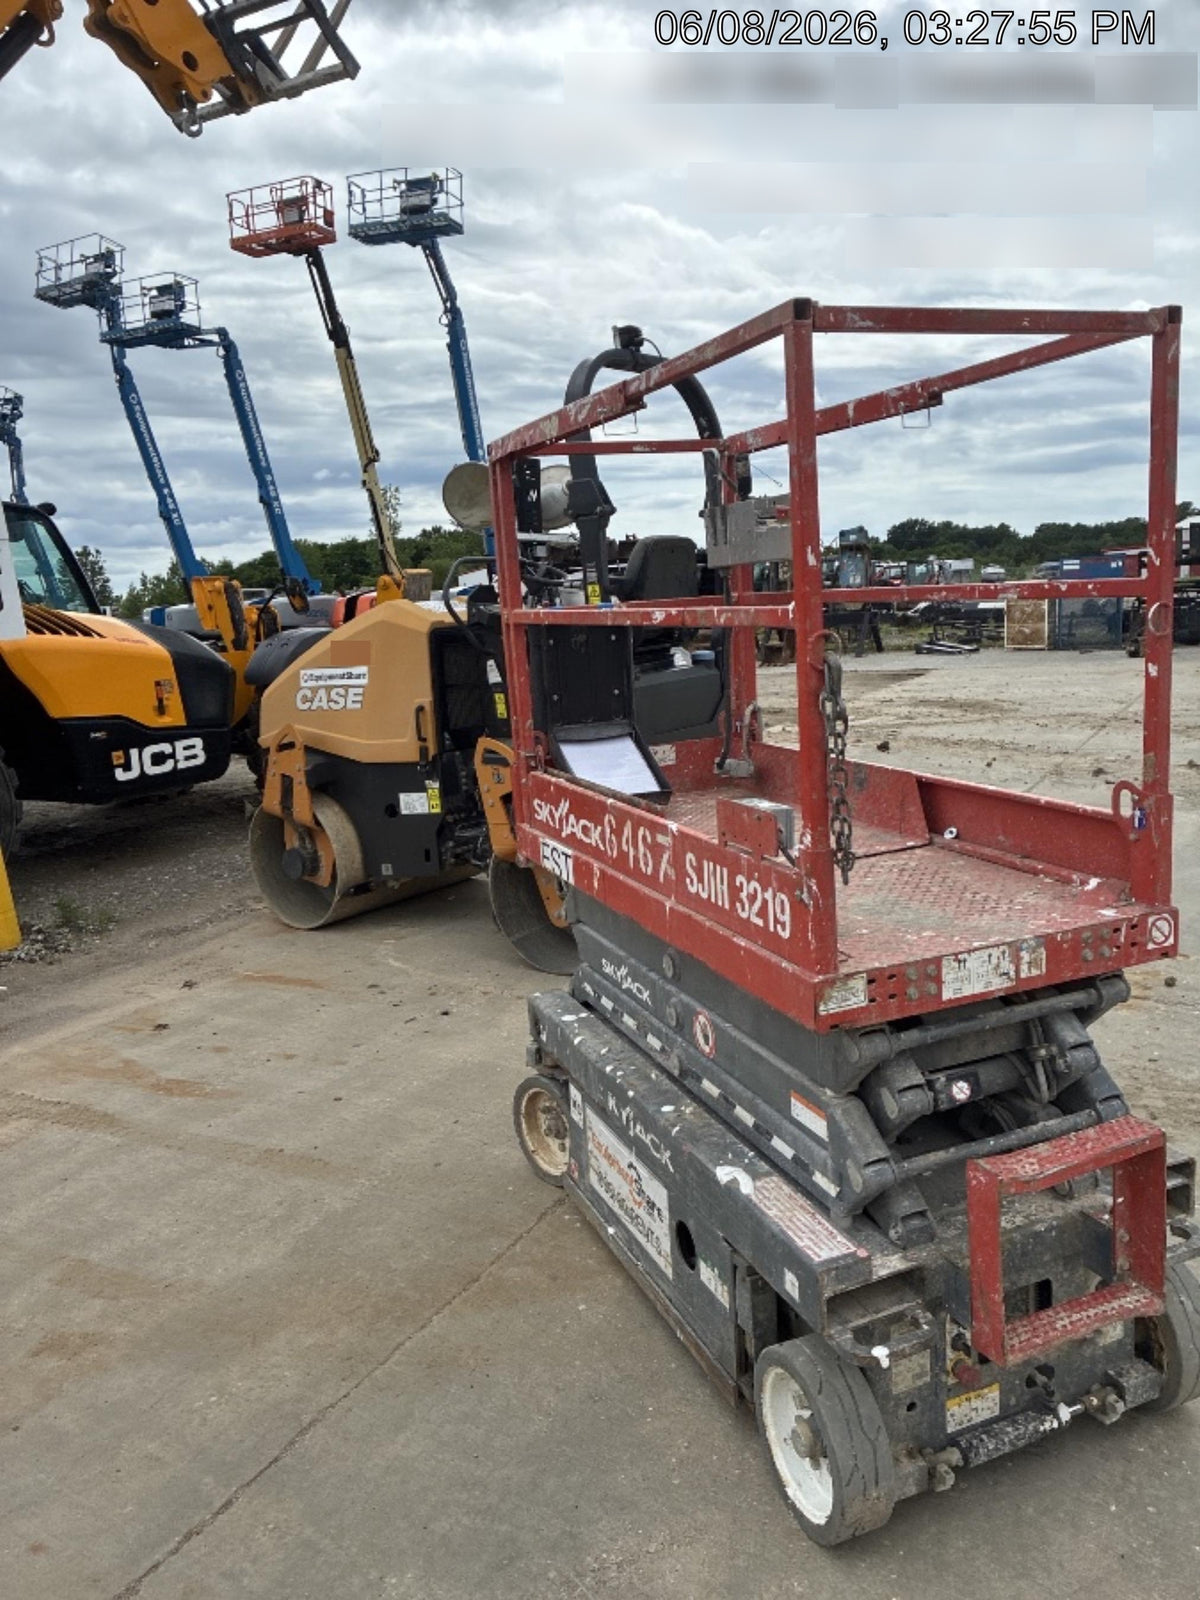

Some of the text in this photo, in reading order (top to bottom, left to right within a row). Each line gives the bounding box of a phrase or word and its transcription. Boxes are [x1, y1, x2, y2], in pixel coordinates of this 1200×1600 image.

[296, 687, 363, 711] CASE
[114, 737, 206, 782] JCB
[533, 798, 605, 851] SKYJACK
[735, 873, 791, 940] 3219
